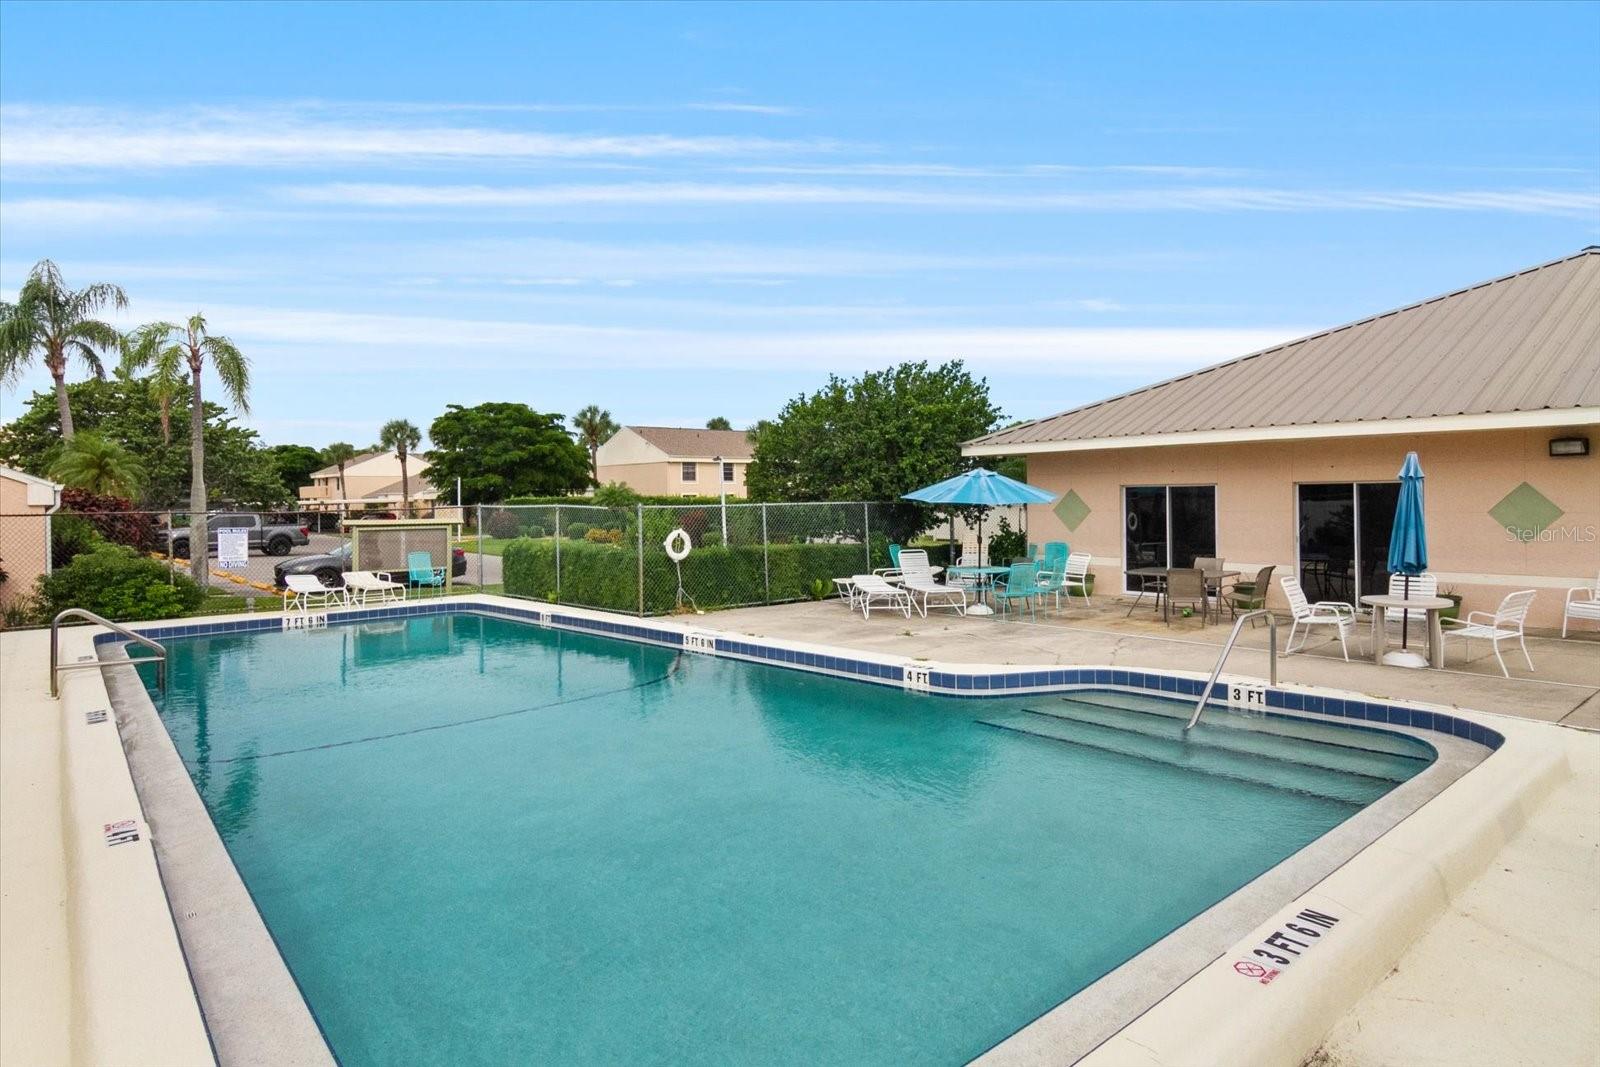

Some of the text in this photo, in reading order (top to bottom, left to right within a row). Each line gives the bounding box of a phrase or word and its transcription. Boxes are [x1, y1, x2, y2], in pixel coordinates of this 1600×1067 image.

[285, 618, 291, 626] 7
[294, 617, 304, 625] FT
[316, 615, 325, 623] IN
[691, 636, 698, 646] FT
[706, 639, 714, 649] IN
[907, 670, 912, 682] 4
[1233, 688, 1241, 701] 3
[1253, 908, 1340, 965] 3 FT 6 IN
